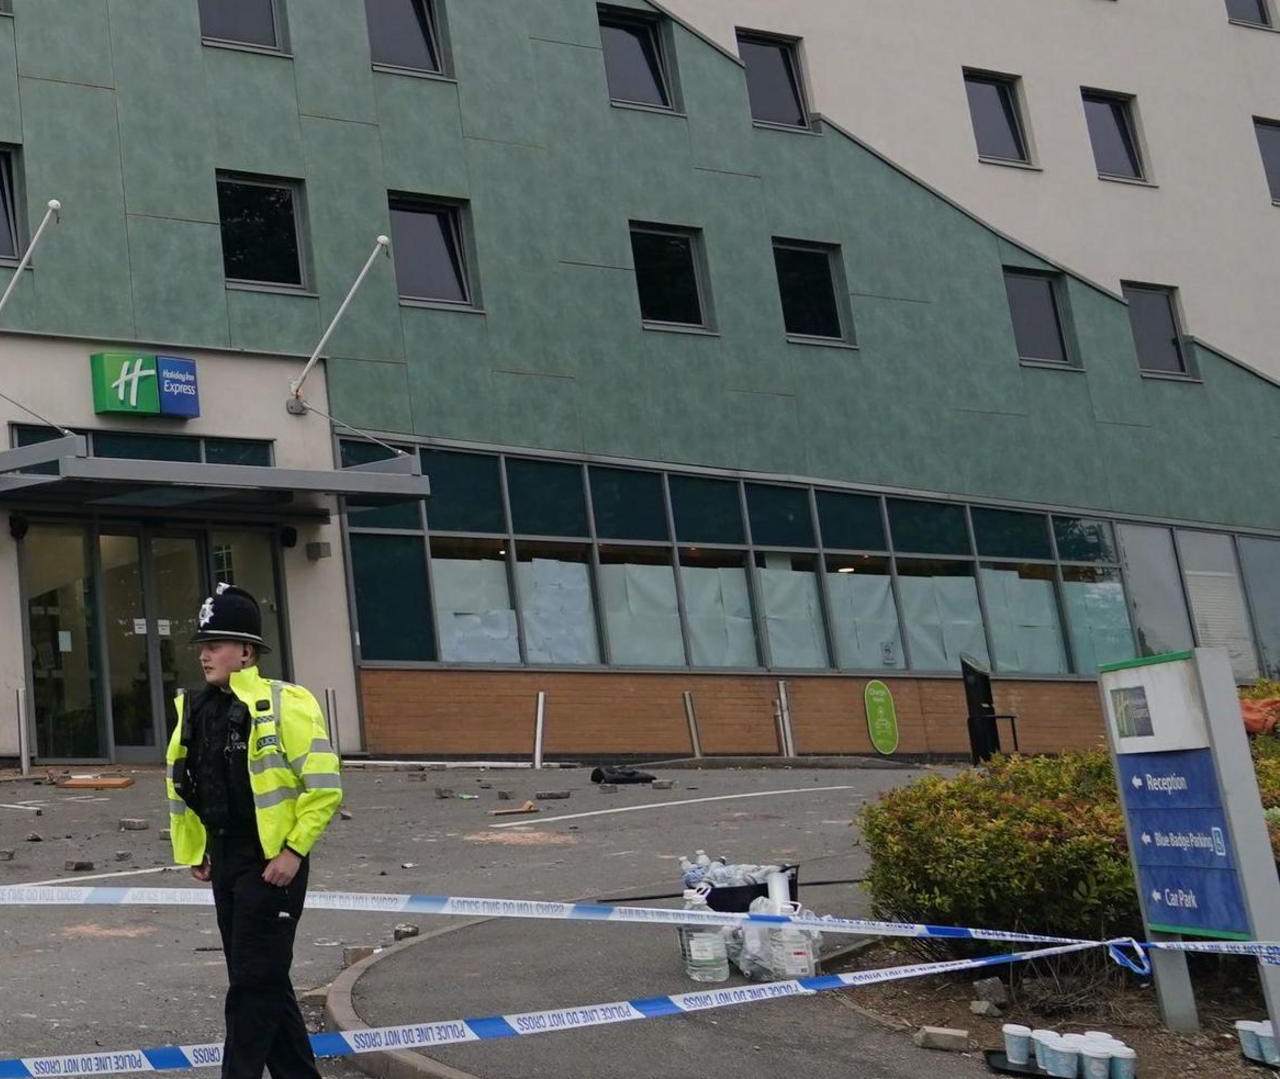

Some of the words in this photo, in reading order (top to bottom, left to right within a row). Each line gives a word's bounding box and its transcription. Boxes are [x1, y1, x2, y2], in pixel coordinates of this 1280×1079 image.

[163, 369, 186, 382] Holiday
[186, 372, 195, 381] Inn
[163, 379, 196, 395] Express
[1145, 773, 1188, 795] Reception
[1154, 832, 1169, 847] Blue
[1169, 832, 1190, 851] Badge
[1190, 833, 1214, 852] Parking
[1165, 888, 1179, 906] Car
[1179, 890, 1198, 908] Park
[683, 994, 713, 1008] CROSS
[715, 991, 733, 1005] NOT
[734, 990, 746, 1003] DO
[566, 1012, 580, 1026] DO
[579, 1010, 601, 1023] LINE
[601, 1004, 631, 1020] POLICE
[517, 1016, 546, 1031] CROSS
[548, 1014, 565, 1028] NOT
[384, 1029, 401, 1046] NOT
[403, 1028, 415, 1044] DO
[416, 1027, 435, 1043] LINE
[435, 1023, 465, 1040] POLICE
[353, 1031, 382, 1049] CROSS
[113, 1054, 142, 1069] POLICE
[192, 1047, 221, 1063] CROSS
[33, 1060, 61, 1075] CROSS
[63, 1059, 80, 1073] NOT
[81, 1058, 92, 1072] DO
[93, 1056, 112, 1071] LINE
